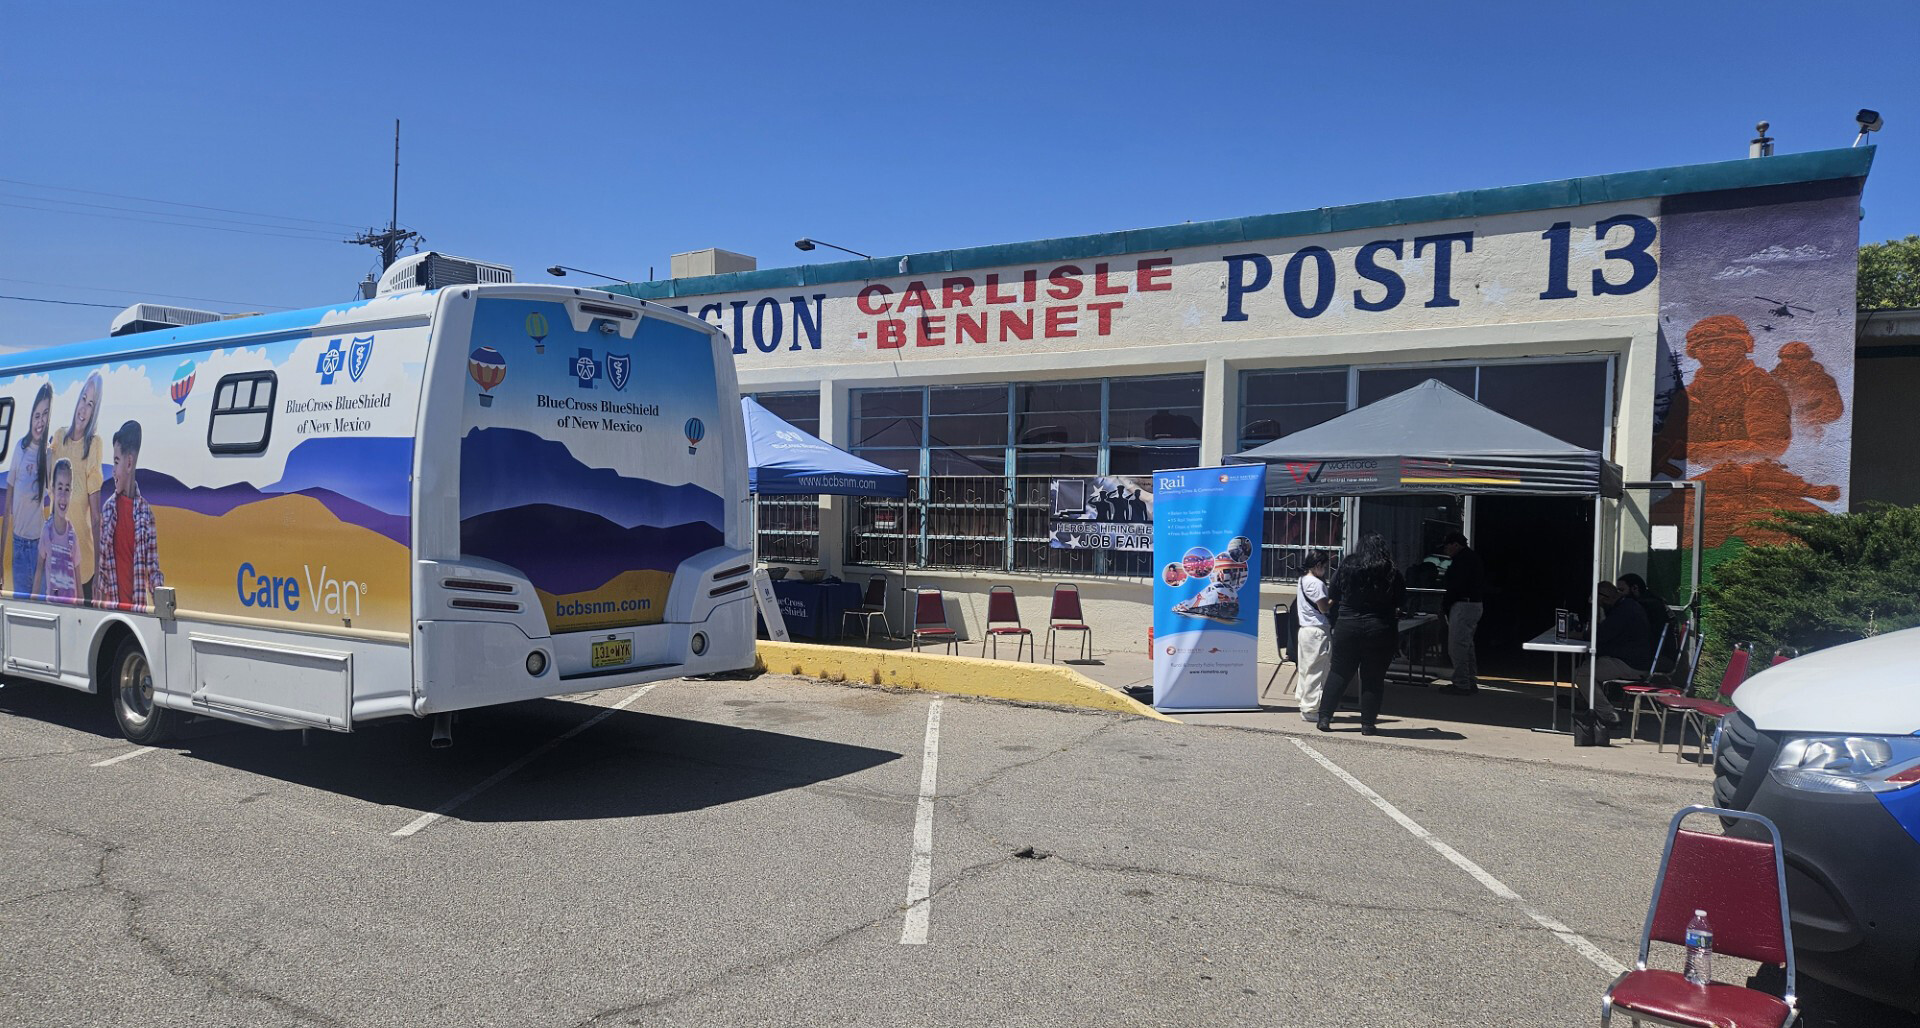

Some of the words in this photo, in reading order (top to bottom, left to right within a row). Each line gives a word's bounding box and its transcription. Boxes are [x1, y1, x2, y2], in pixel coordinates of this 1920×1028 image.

[1221, 230, 1474, 323] POST
[1539, 214, 1659, 301] 13
[856, 256, 1173, 316] CARLISLE
[857, 301, 1124, 350] -BENNET
[285, 398, 333, 414] BlueCross
[335, 393, 392, 410] BlueShield
[536, 394, 598, 411] BlueCross
[601, 400, 660, 416] BlueShield
[297, 420, 308, 433] of
[309, 420, 335, 433] New
[333, 417, 371, 432] Mexico
[557, 416, 569, 428] of
[572, 416, 599, 430] New
[602, 418, 643, 433] Mexico
[798, 475, 876, 490] www.bcbsnm.com
[1159, 475, 1185, 490] Rail
[1057, 522, 1098, 533] HEROES
[1100, 523, 1137, 534] HIRING
[1081, 534, 1110, 548] JOB
[1116, 535, 1151, 549] FAIR
[237, 562, 300, 611] Care
[556, 598, 651, 617] bcbsnm.com
